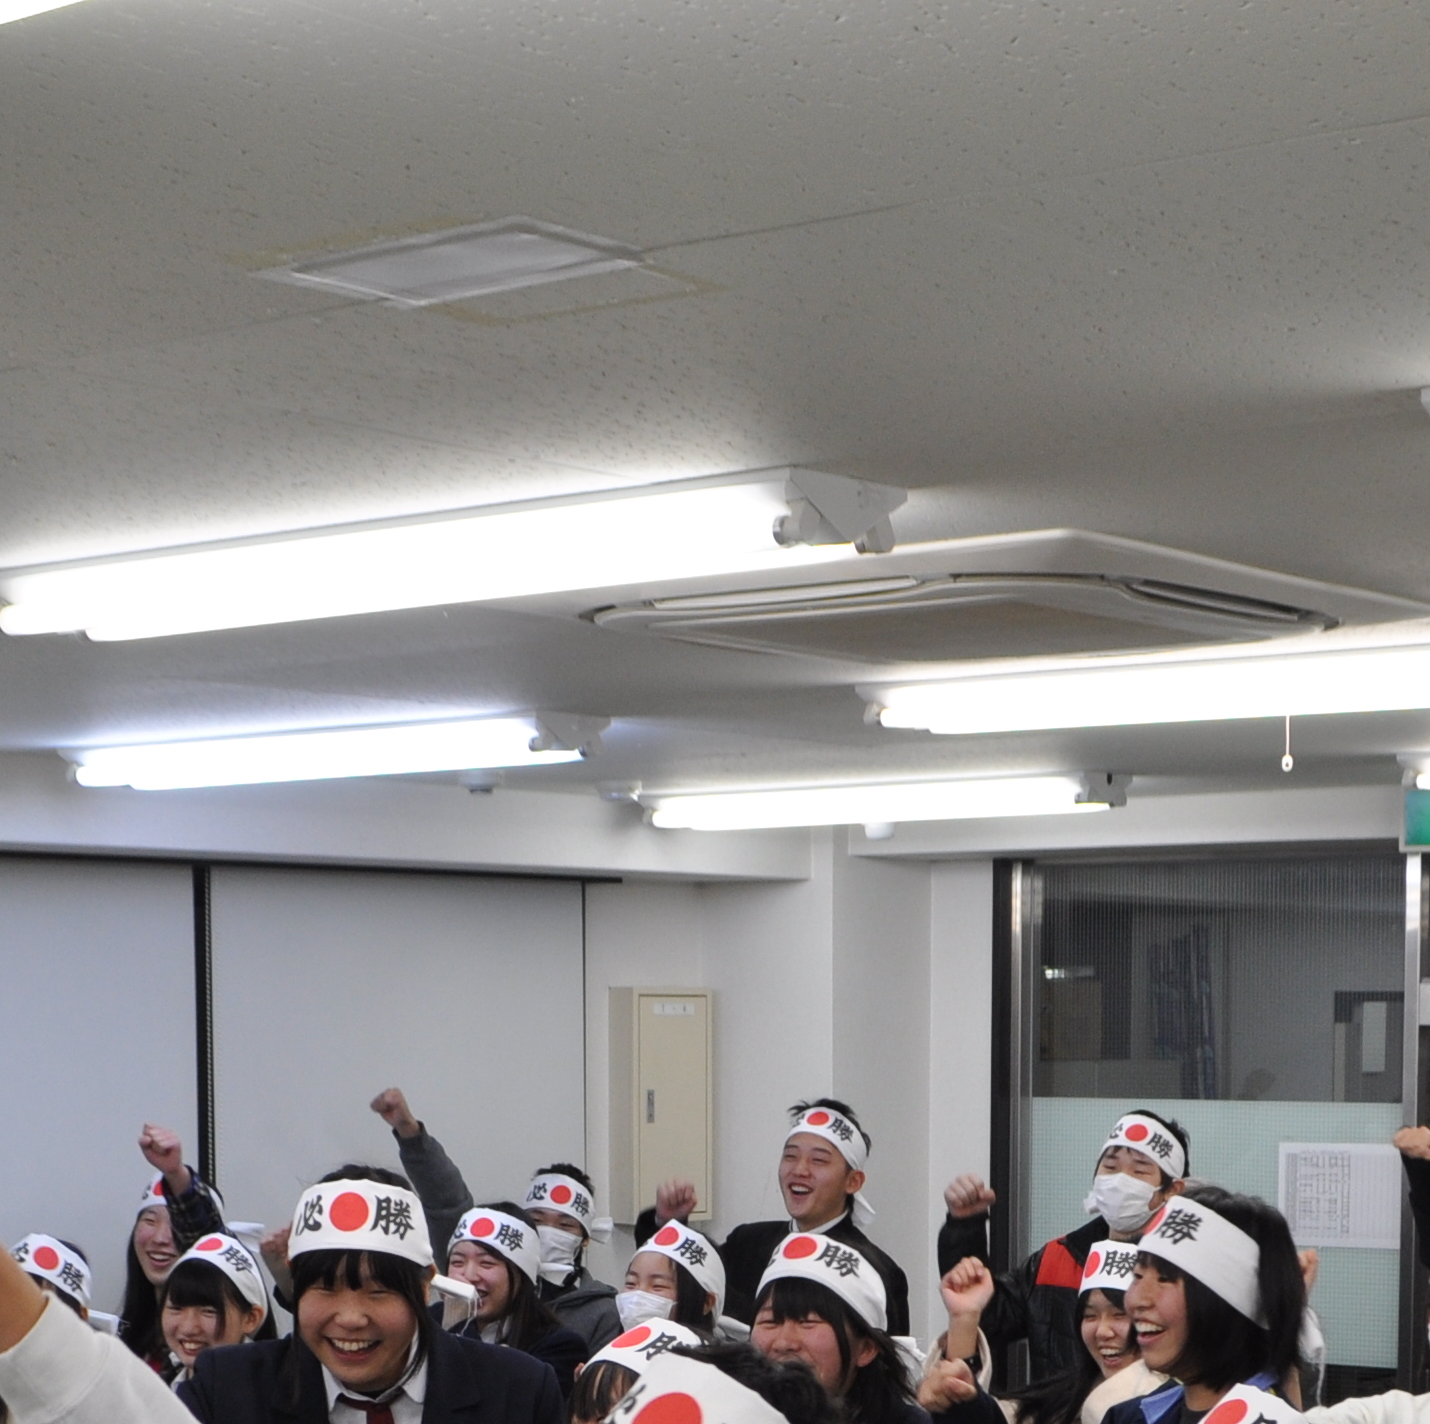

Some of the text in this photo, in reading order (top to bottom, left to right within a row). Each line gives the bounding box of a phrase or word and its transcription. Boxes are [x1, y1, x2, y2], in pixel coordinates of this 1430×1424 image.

[295, 1193, 416, 1241] 必勝
[525, 1181, 590, 1218] 必勝
[1156, 1207, 1204, 1246] 勝
[218, 1244, 254, 1273] 勝
[673, 1235, 710, 1268] 勝
